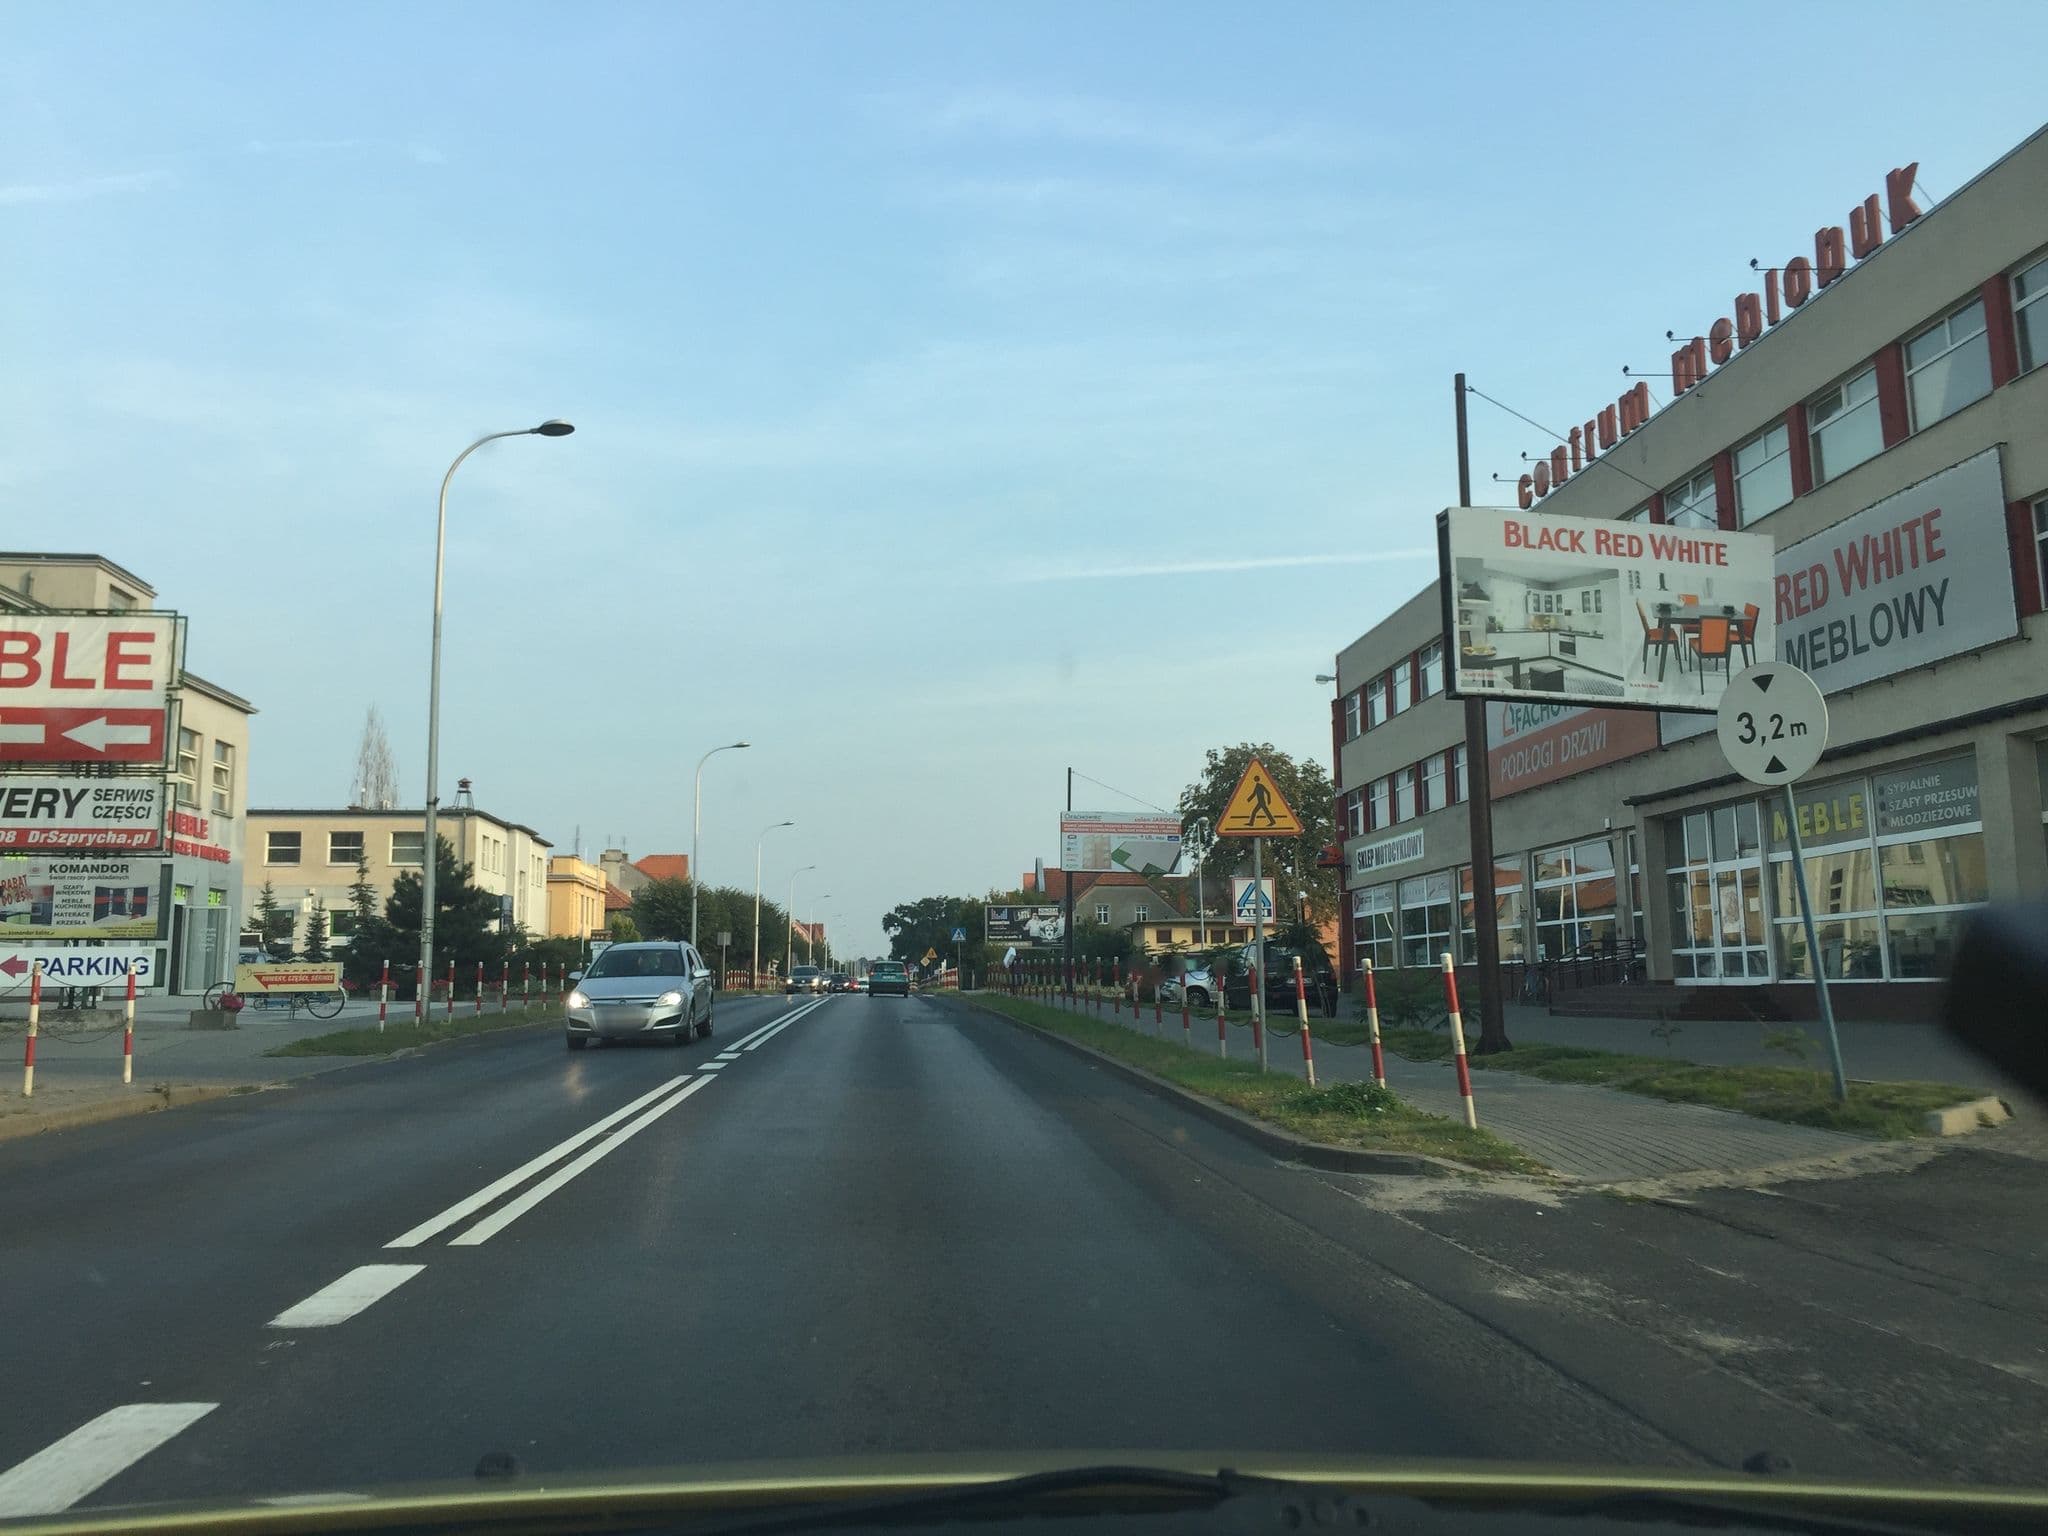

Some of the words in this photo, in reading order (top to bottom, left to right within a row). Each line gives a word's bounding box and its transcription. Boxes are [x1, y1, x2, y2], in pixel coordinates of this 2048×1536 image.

[1503, 520, 1587, 554] BLACK
[1595, 528, 1643, 558] RED
[1648, 533, 1729, 567] WHITE
[1775, 563, 1829, 625] RED
[1833, 507, 1946, 597] WHITE
[1785, 577, 1949, 674] MEBLOWY
[0, 631, 156, 690] BLE
[1789, 721, 1808, 737] m
[1501, 738, 1553, 784] PODŁOGI
[1561, 720, 1607, 764] DRZWI
[1887, 775, 1942, 795] SYPIALNIE
[0, 788, 90, 819] ERY
[93, 788, 155, 803] SERWIS
[92, 803, 152, 823] CZĘŚCI
[1888, 795, 1921, 812] SZAFY
[1889, 804, 1973, 829] MŁODZIEŻOWE
[28, 831, 151, 846] DrSzprycha.pl
[1357, 849, 1374, 870] SKLEP
[1375, 834, 1423, 866] MOTOCYKLOWY
[49, 864, 129, 874] KOMANDOR
[1240, 909, 1268, 917] ALI
[34, 956, 149, 976] PARKING
